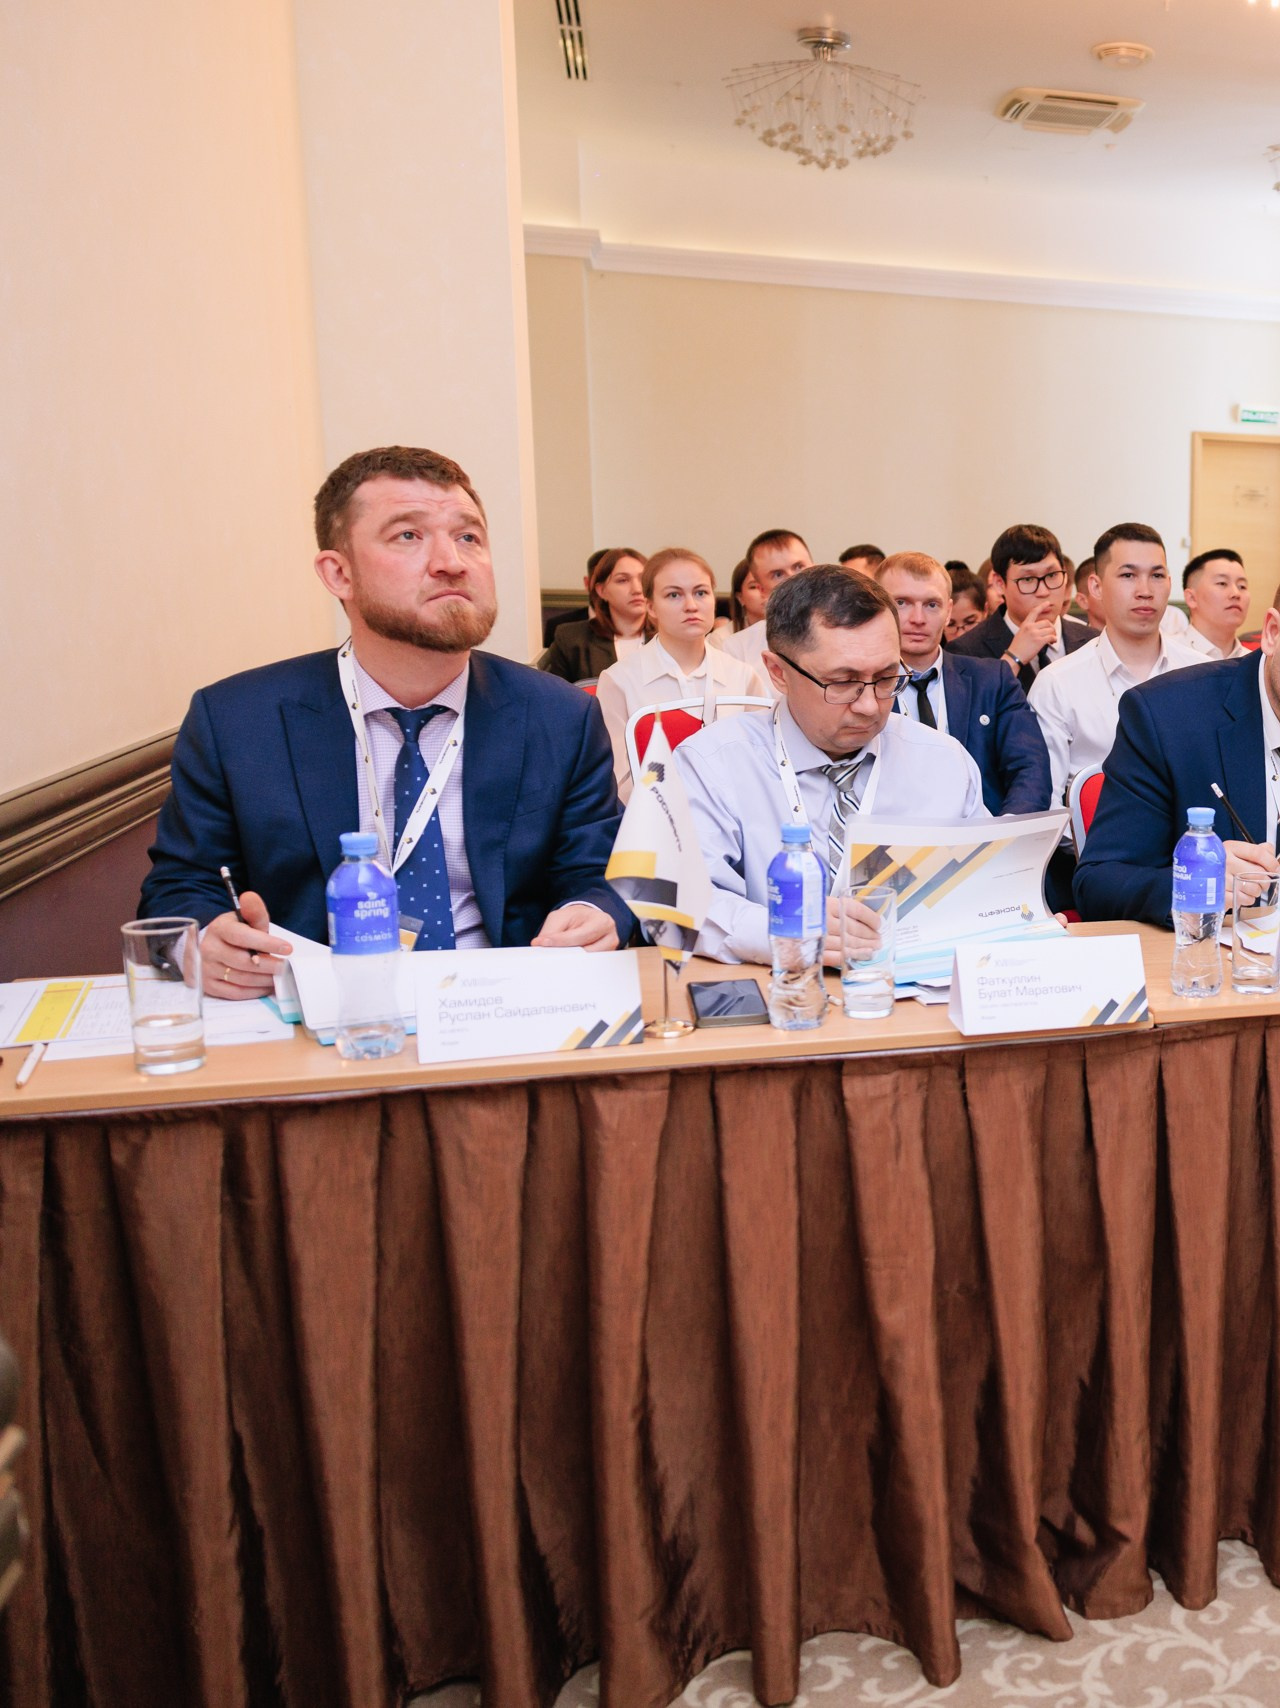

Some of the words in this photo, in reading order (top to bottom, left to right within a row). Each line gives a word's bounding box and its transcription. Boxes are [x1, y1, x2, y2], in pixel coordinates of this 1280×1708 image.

[357, 898, 387, 910] saint
[353, 907, 390, 920] spring
[976, 974, 1042, 988] Фаткуллин
[978, 987, 1012, 1001] Булат
[1015, 984, 1083, 997] Маратович
[437, 995, 504, 1010] Хамидов
[438, 1010, 491, 1026] Руслан
[494, 1001, 597, 1020] Сайдаланович
